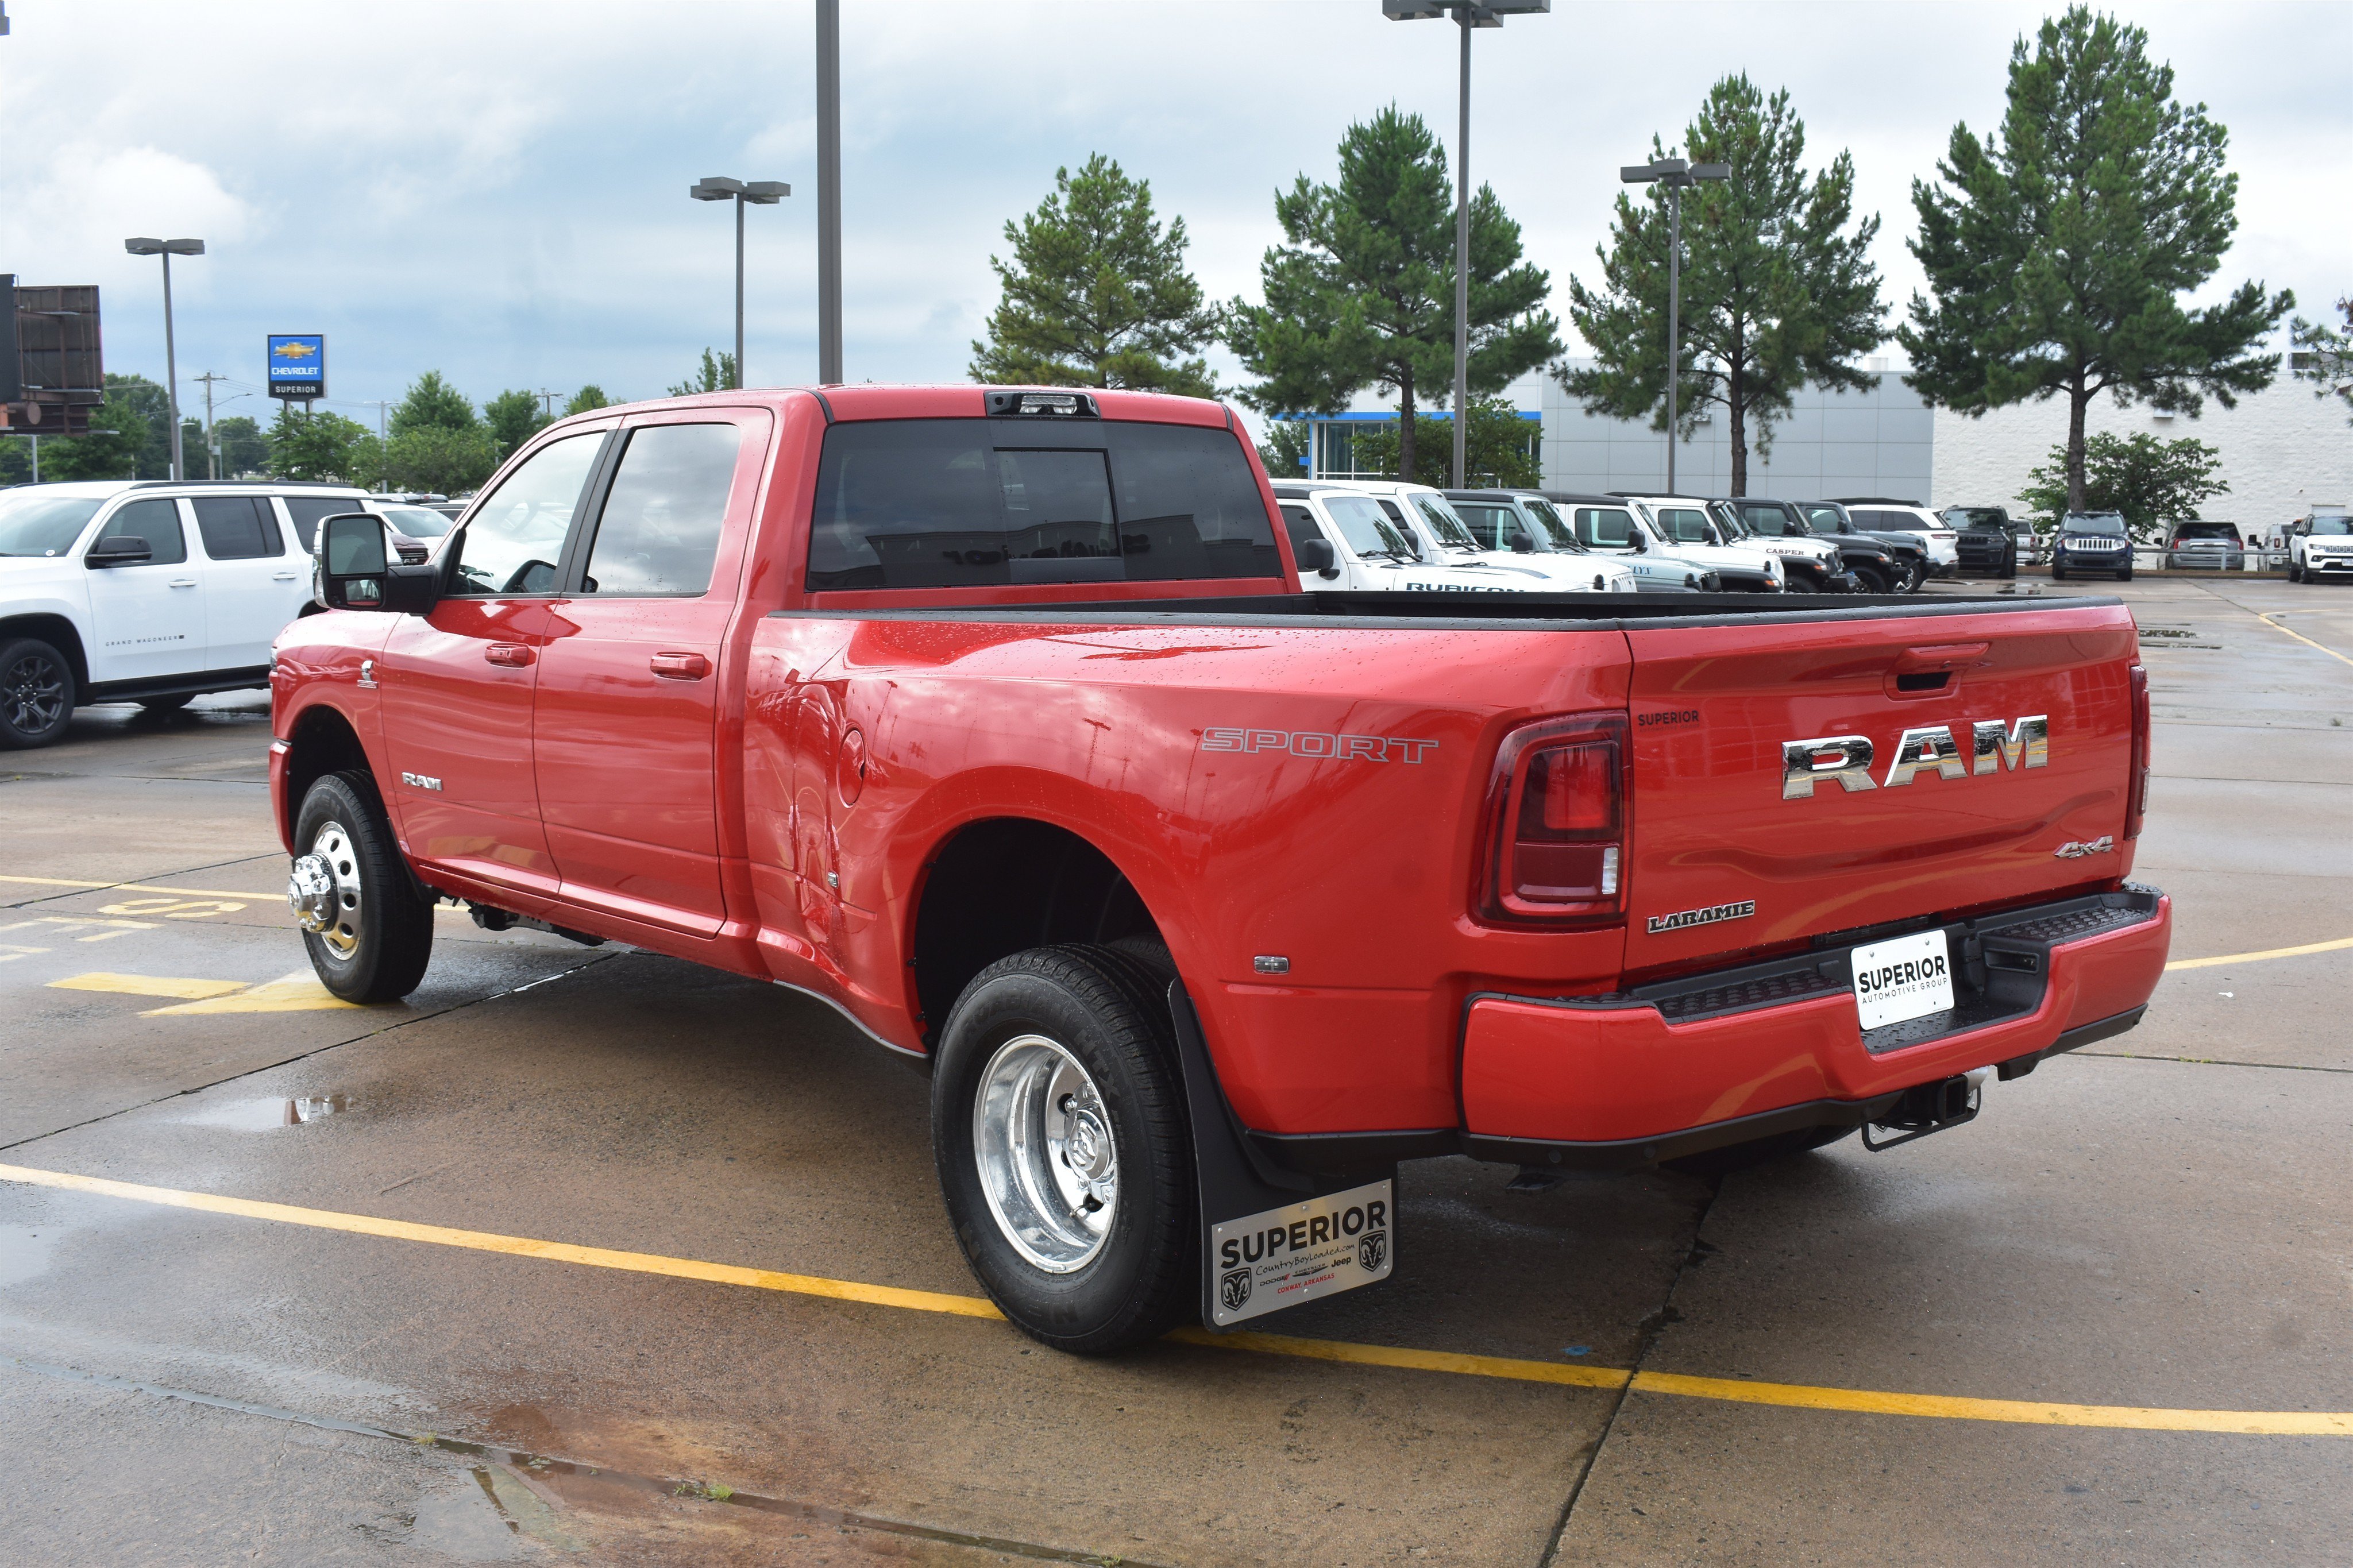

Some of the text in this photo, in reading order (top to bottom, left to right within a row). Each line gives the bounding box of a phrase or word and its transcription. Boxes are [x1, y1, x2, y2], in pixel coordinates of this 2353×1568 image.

[272, 367, 318, 375] CHEVROLET
[1638, 710, 1699, 726] SUPERIOR
[1202, 727, 1438, 764] SPORT
[1782, 715, 2048, 800] RAM
[402, 772, 443, 791] RAM
[1647, 900, 1755, 933] LARAMIE
[1859, 955, 1946, 993] SUPERIOR
[1862, 978, 1947, 1004] AUTOMOTIVE GROUP
[1074, 1028, 1123, 1104] HTX
[1221, 1200, 1387, 1269] SUPERIOR
[1256, 1243, 1355, 1276] CountryBoyLoaded.com
[1295, 1263, 1326, 1273] CHRYSLER
[1331, 1257, 1352, 1267] Jeep
[1260, 1275, 1287, 1287] DODGE
[1278, 1273, 1334, 1294] CONWAY, ARKANSAS
